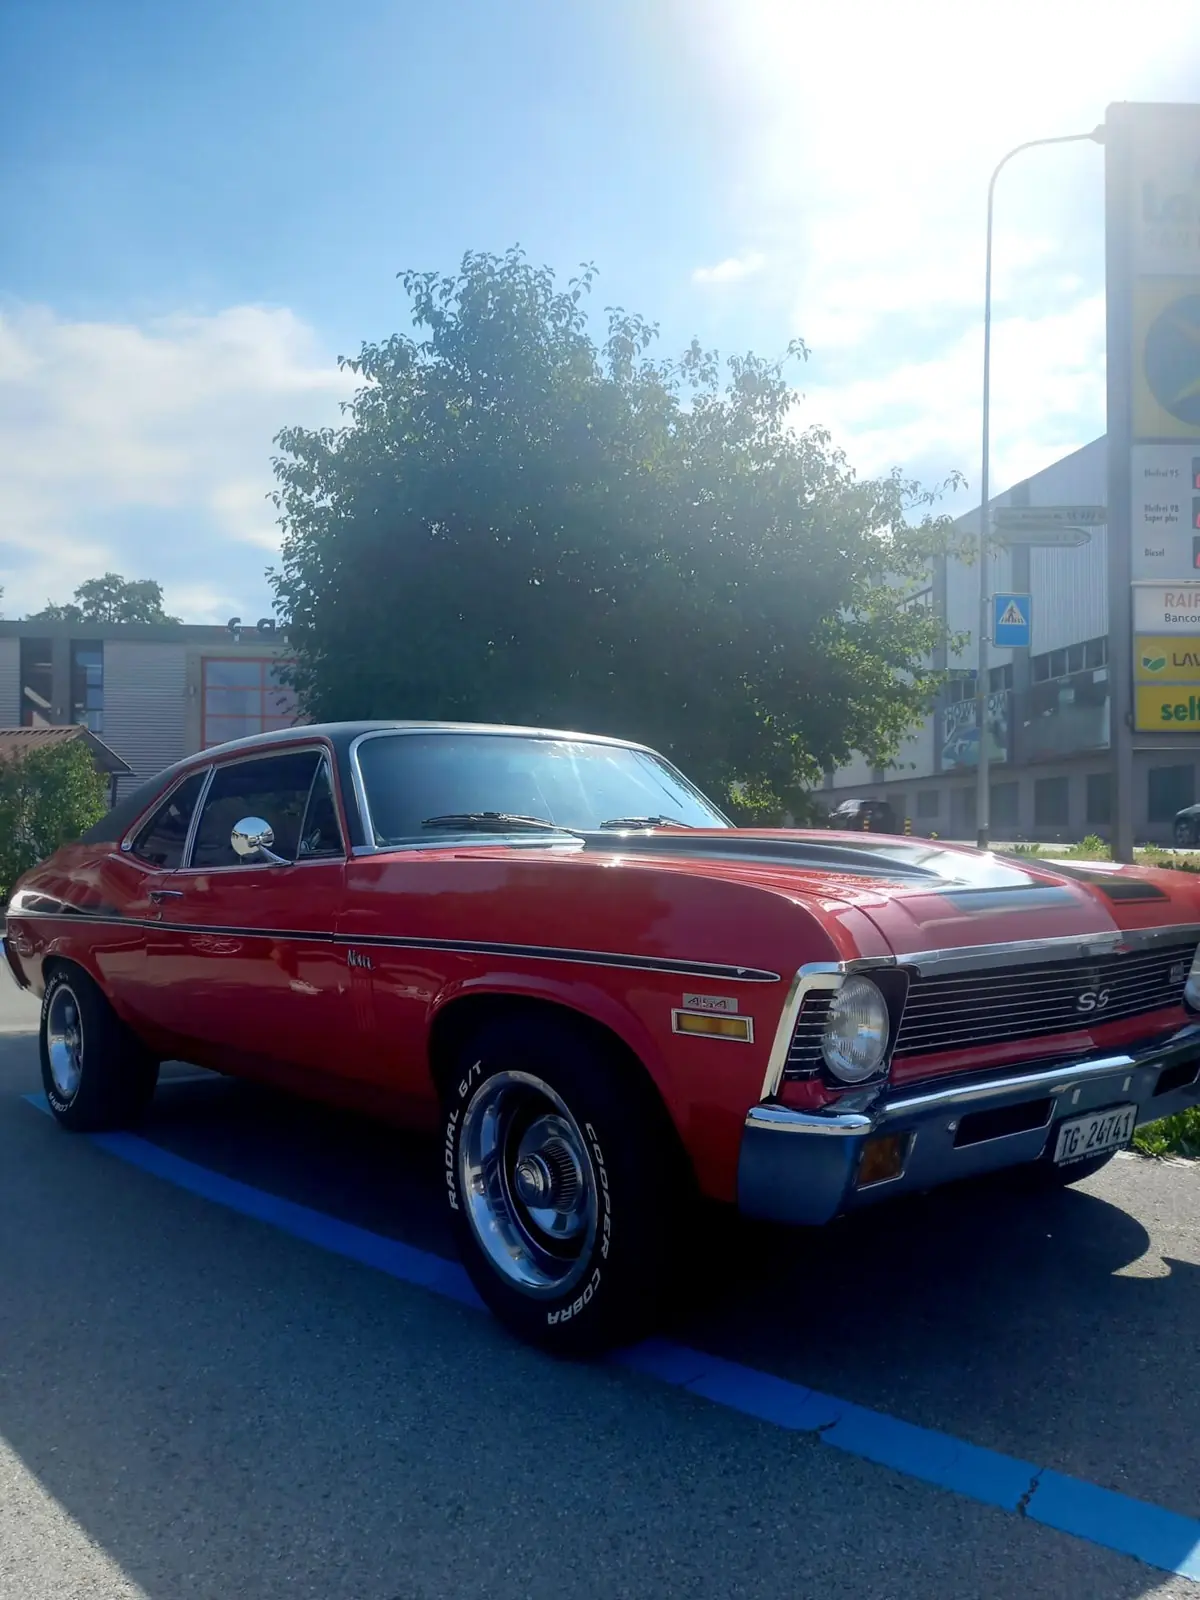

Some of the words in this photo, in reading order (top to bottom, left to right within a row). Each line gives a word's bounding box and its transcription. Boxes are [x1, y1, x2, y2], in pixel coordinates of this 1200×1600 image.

[1169, 469, 1180, 478] 95
[1169, 503, 1180, 513] 98
[1144, 514, 1163, 524] Super
[1164, 513, 1179, 524] plus
[1144, 548, 1165, 557] Diesel
[1076, 989, 1110, 1012] SS
[445, 1108, 460, 1210] RADIAL
[458, 1060, 482, 1098] G/T
[585, 1122, 611, 1259] COOPER
[547, 1268, 601, 1325] COBRA
